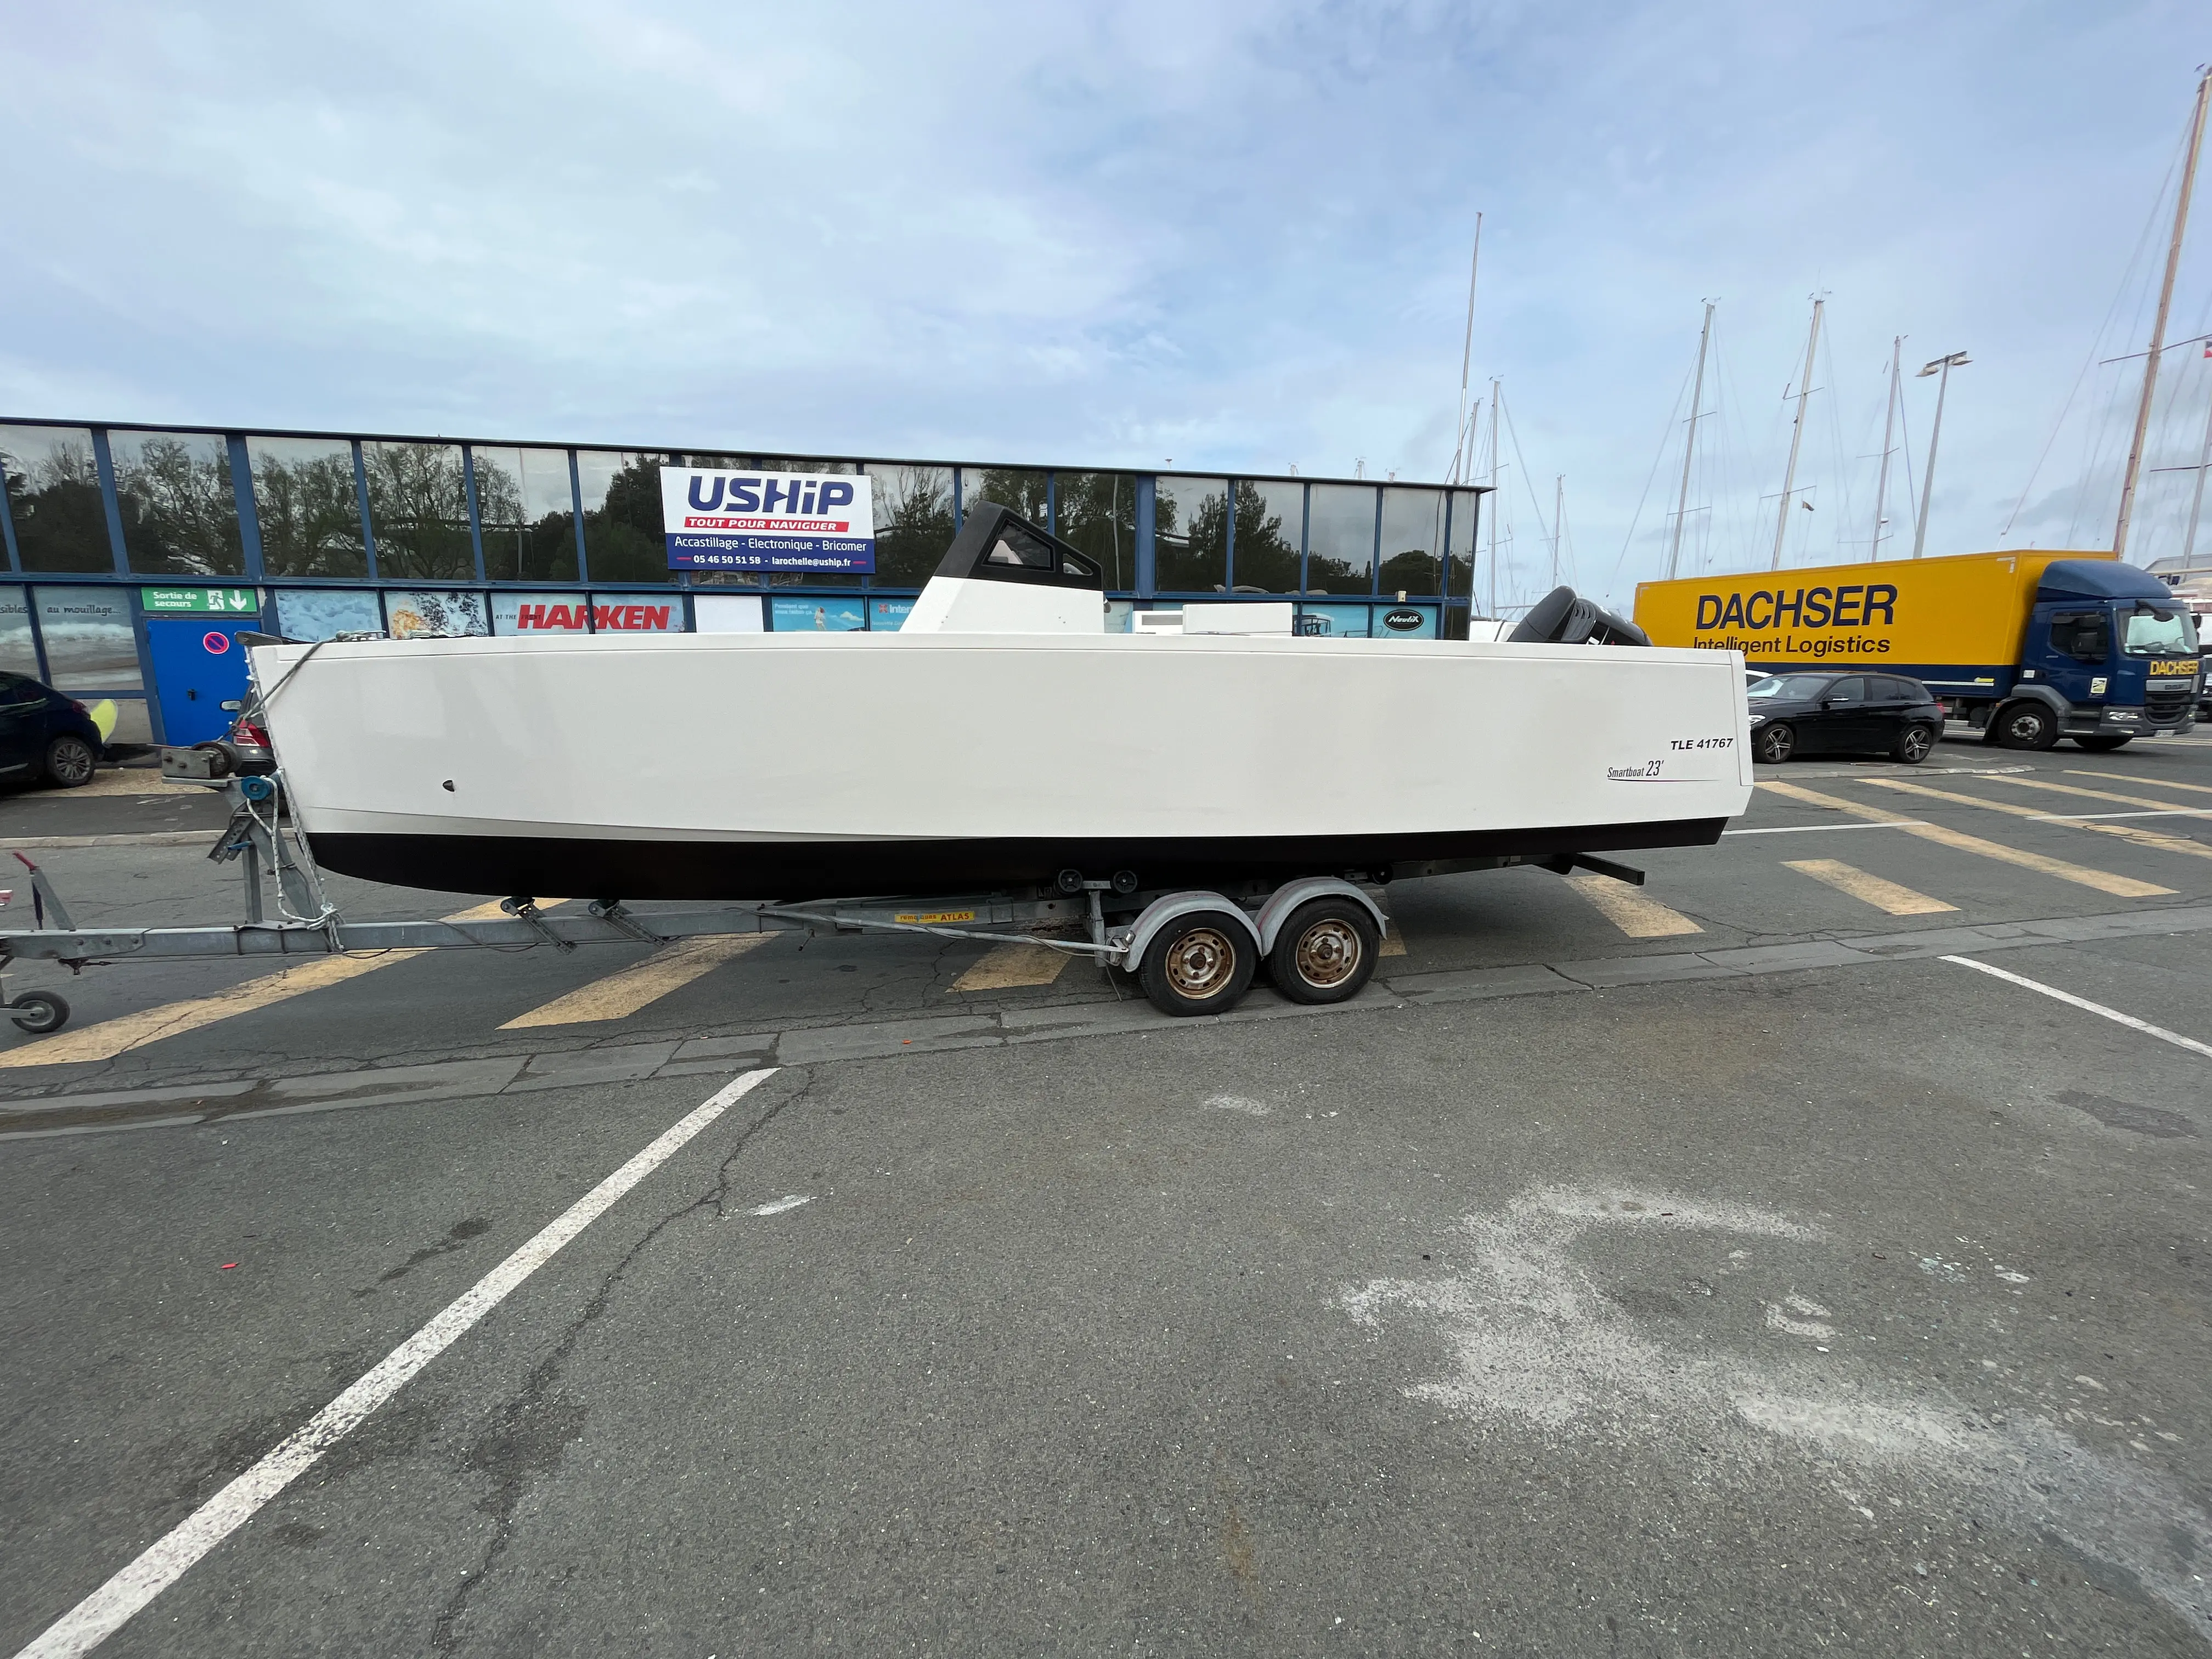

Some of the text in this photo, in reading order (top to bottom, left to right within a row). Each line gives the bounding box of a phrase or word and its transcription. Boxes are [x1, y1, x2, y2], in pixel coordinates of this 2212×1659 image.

[690, 518, 837, 531] TOUT POUR NAVIGUER
[675, 535, 738, 550] Accastillage
[748, 538, 813, 551] Electronique
[822, 540, 867, 551] Bricomer
[693, 555, 706, 563] 05
[707, 555, 720, 563] 46
[721, 556, 733, 564] 50
[735, 556, 747, 565] 51
[749, 556, 761, 565] 58
[771, 556, 851, 568] larochelle@uship.fr
[153, 591, 198, 600] Sortie de
[1696, 584, 1897, 630] DACHSER
[517, 604, 670, 630] HARKEN
[1786, 635, 1891, 657] Logistics
[2149, 661, 2199, 675] DACHSER
[1671, 738, 1733, 750] TLE 41767
[1607, 766, 1644, 778] Smartboat
[940, 912, 969, 921] ATLAS
